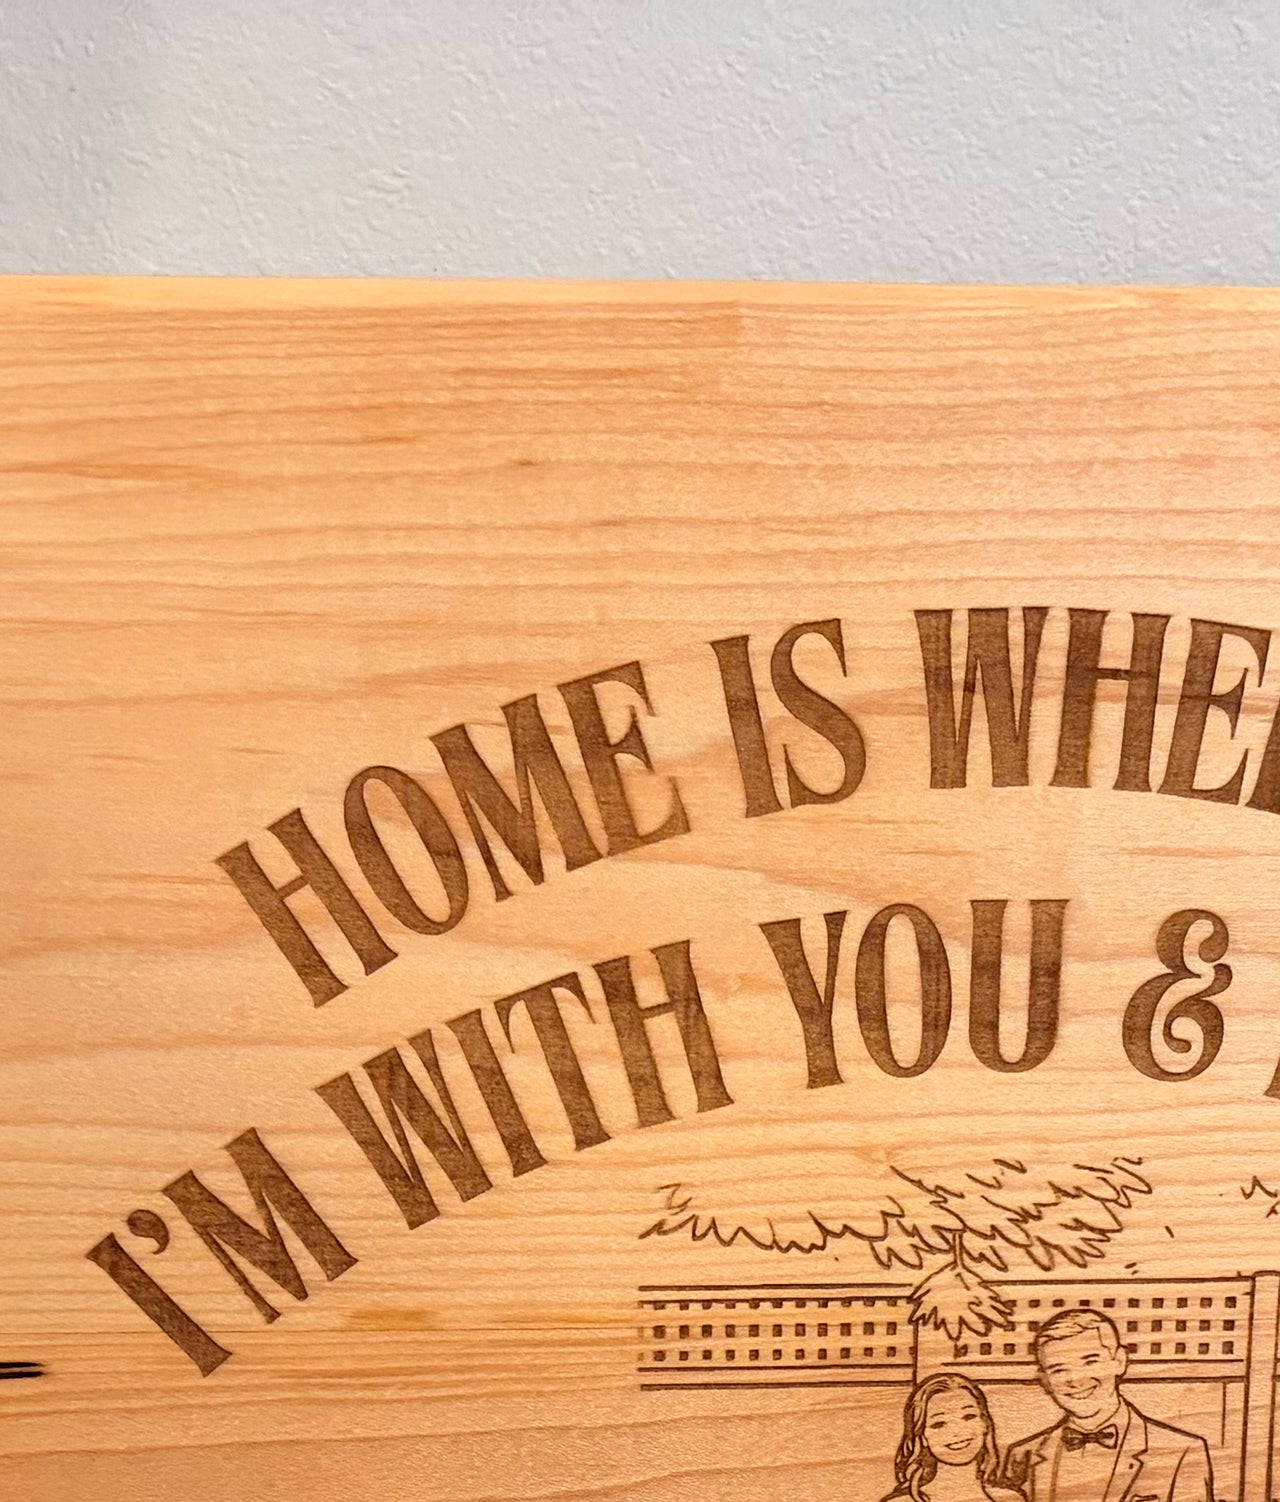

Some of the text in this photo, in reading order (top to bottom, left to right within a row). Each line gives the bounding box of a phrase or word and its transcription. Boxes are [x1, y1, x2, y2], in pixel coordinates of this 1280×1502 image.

[213, 660, 692, 1008] HOME
[710, 617, 868, 819] IS
[85, 1126, 359, 1378] I'M
[315, 938, 736, 1231] WITH
[758, 898, 1070, 1090] YOU
[1121, 908, 1235, 1083] &
